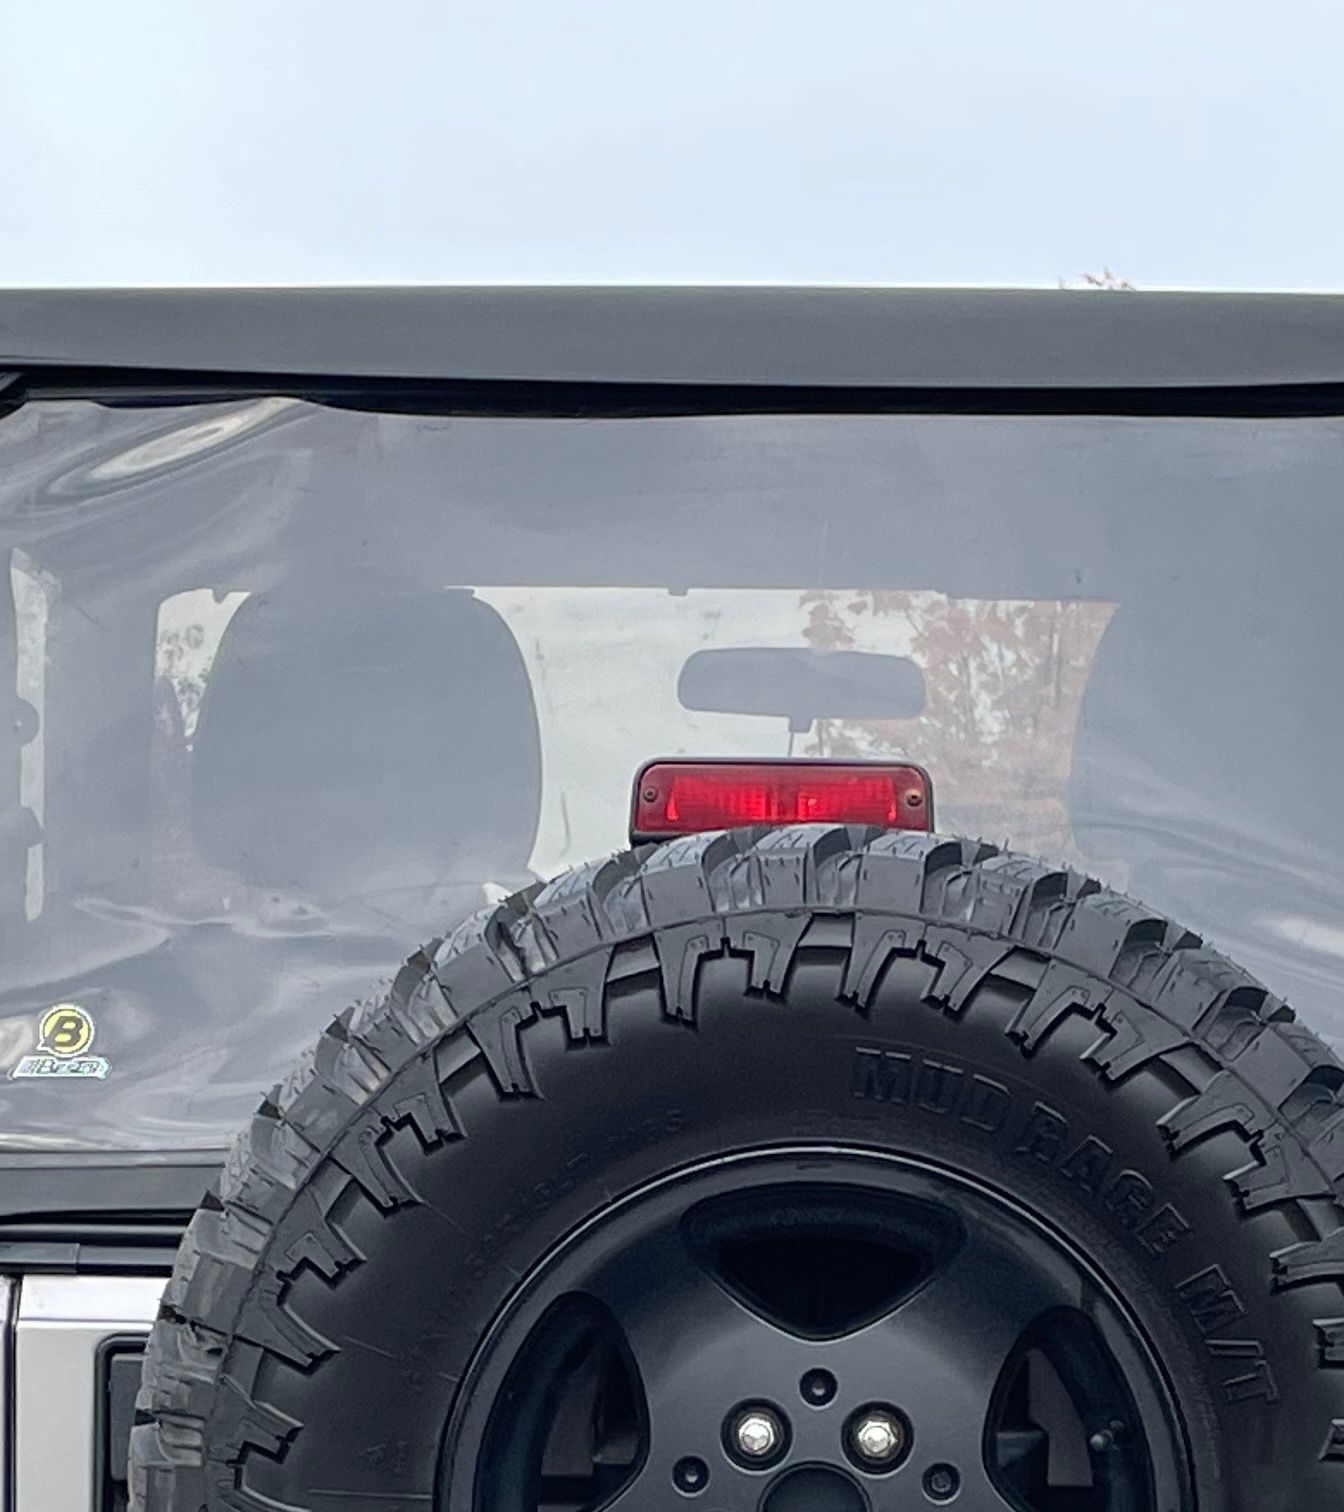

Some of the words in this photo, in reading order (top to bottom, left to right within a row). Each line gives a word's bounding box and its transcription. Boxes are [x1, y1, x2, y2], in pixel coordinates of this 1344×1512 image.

[851, 1045, 1011, 1132] MUD
[1015, 1100, 1190, 1258] RAGE
[1175, 1263, 1280, 1404] M/T
